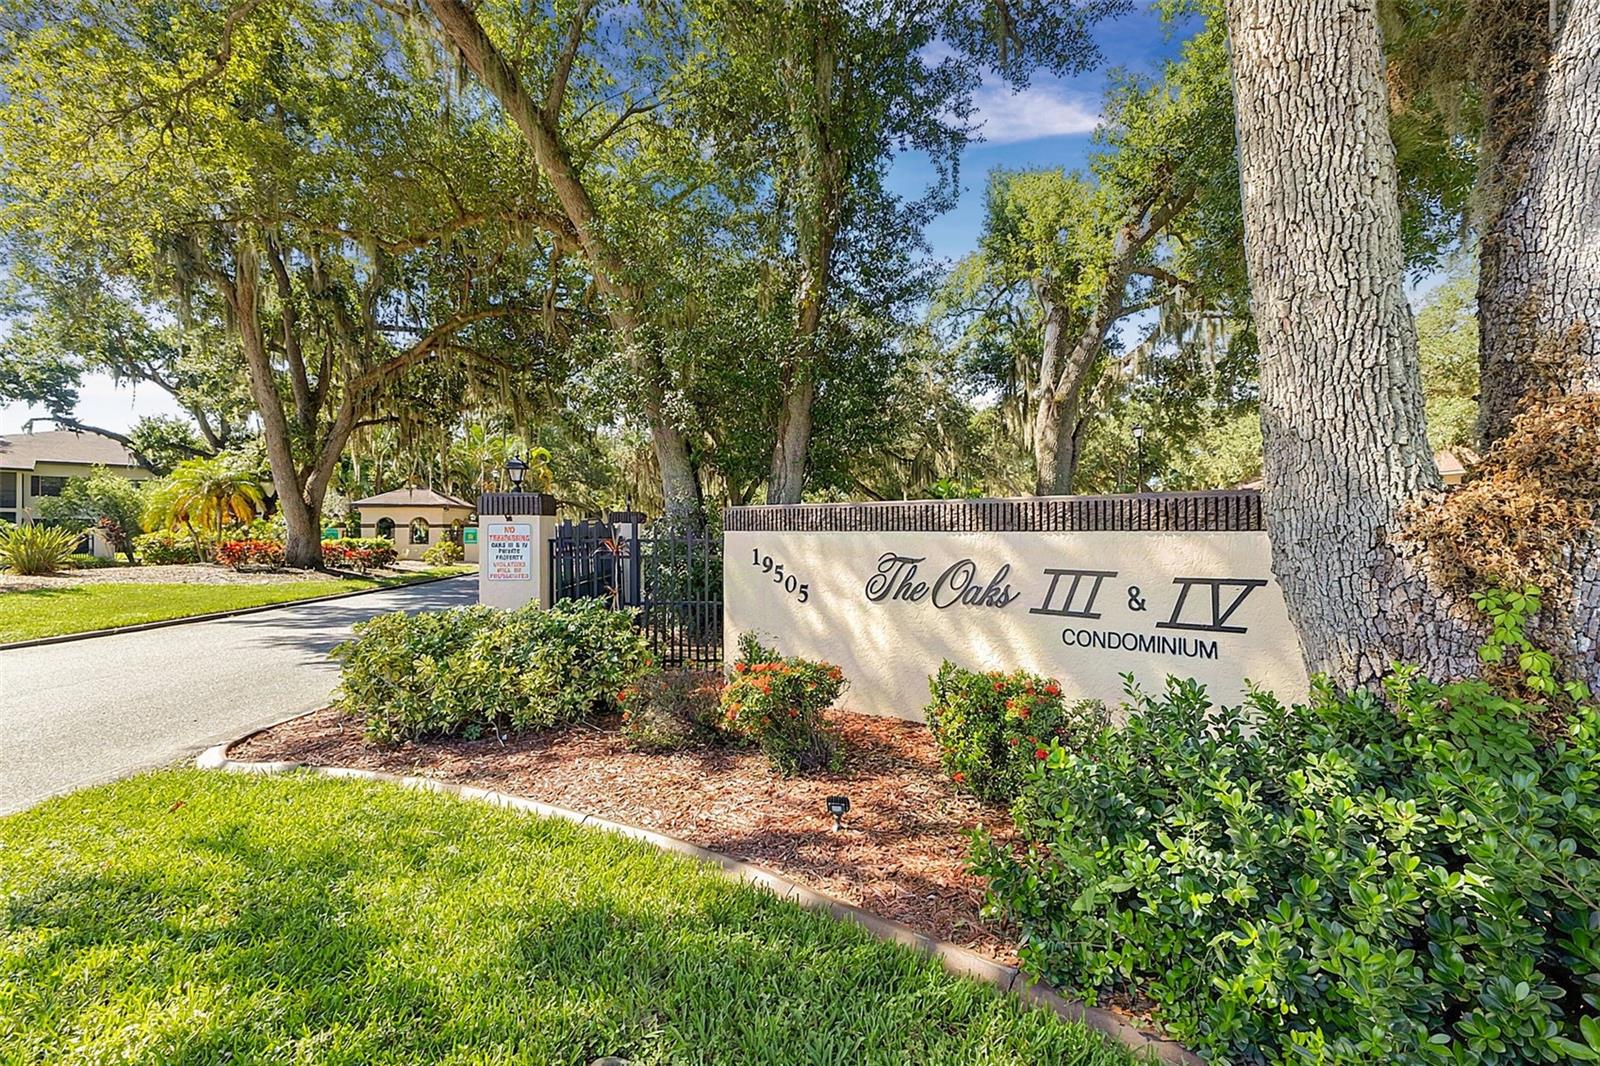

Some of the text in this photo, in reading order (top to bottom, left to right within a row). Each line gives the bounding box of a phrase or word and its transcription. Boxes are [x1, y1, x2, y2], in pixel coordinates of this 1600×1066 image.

[752, 548, 809, 604] 19505
[865, 552, 1269, 634] The Oaks III & IV
[1061, 628, 1219, 660] CONDOMINIUM
